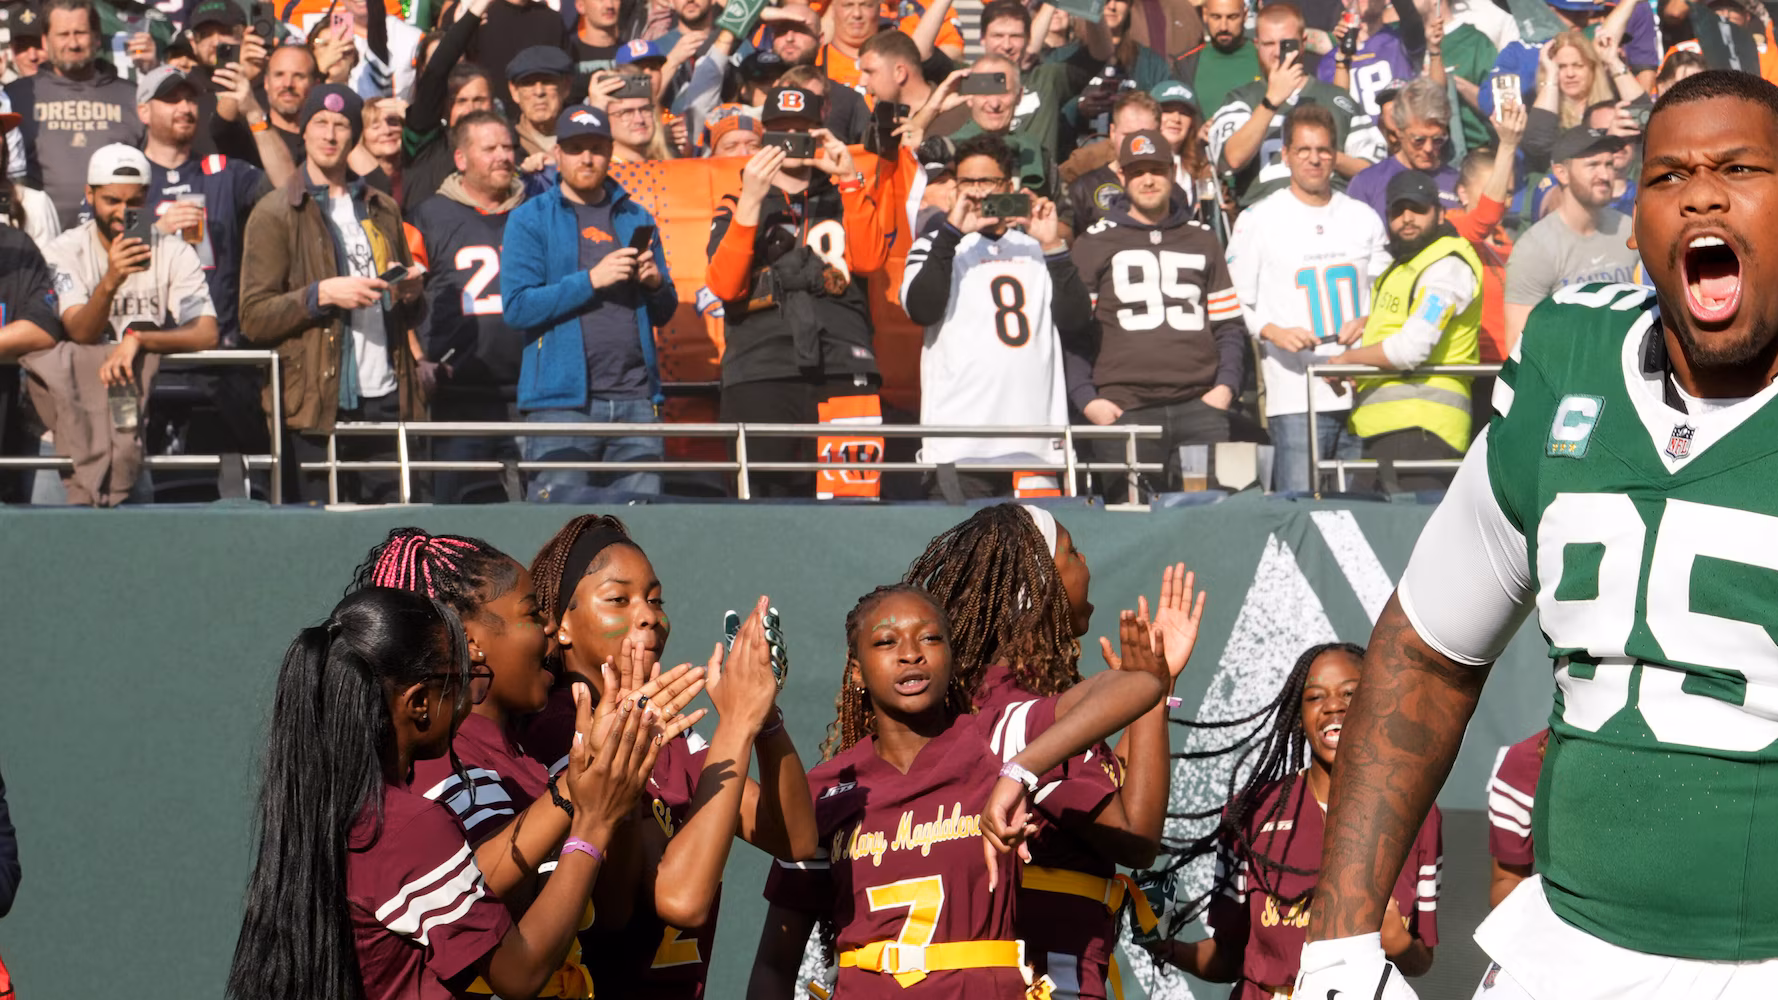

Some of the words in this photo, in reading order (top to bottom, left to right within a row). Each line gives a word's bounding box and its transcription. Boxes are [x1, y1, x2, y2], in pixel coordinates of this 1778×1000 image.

[34, 99, 122, 123] OREGON
[777, 90, 805, 111] B
[47, 120, 110, 132] DUCKS
[990, 274, 1032, 348] 8
[1111, 248, 1207, 332] 95
[1295, 263, 1362, 338] 10
[1551, 397, 1598, 441] C
[652, 798, 675, 838] St
[843, 819, 887, 867] Mary
[866, 874, 945, 947] 7
